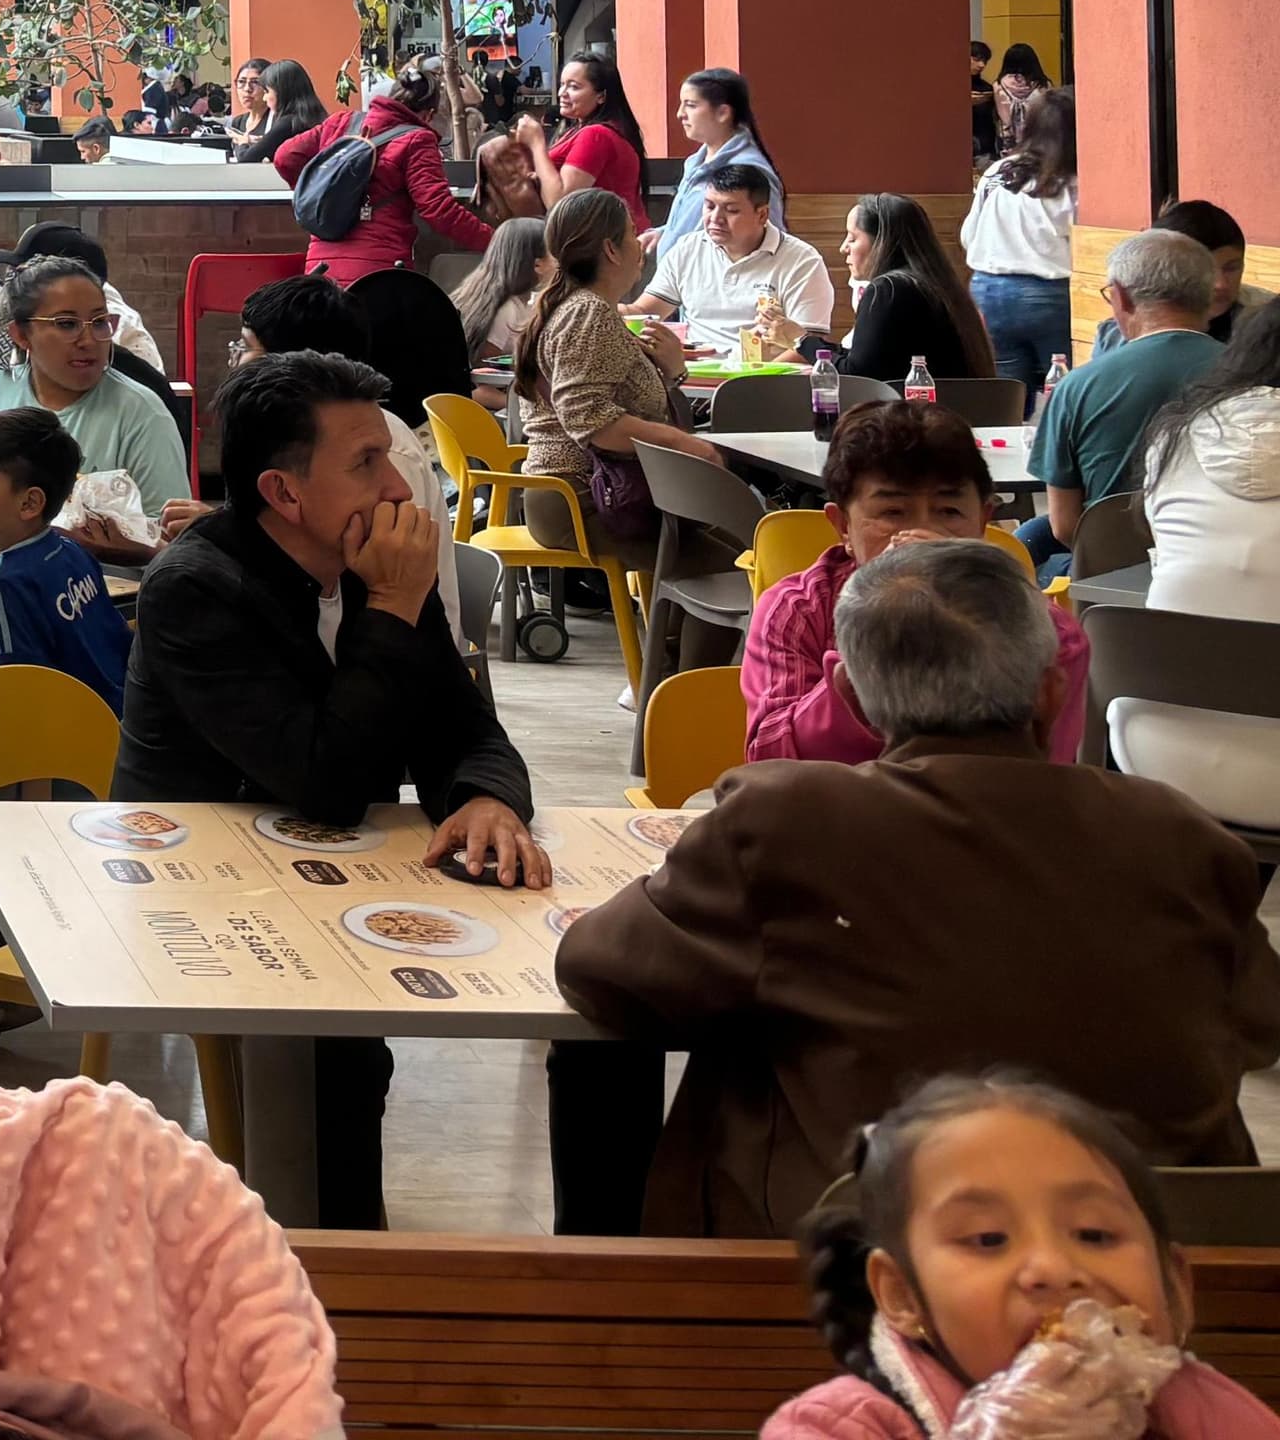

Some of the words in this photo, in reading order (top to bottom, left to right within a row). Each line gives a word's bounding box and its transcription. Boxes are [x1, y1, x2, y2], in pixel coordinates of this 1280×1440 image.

[139, 910, 233, 978] MONTOLIVO
[227, 917, 251, 932] DE
[239, 934, 285, 971] SABOR
[249, 910, 277, 935] LLENA
[280, 944, 319, 981] SEMANA
